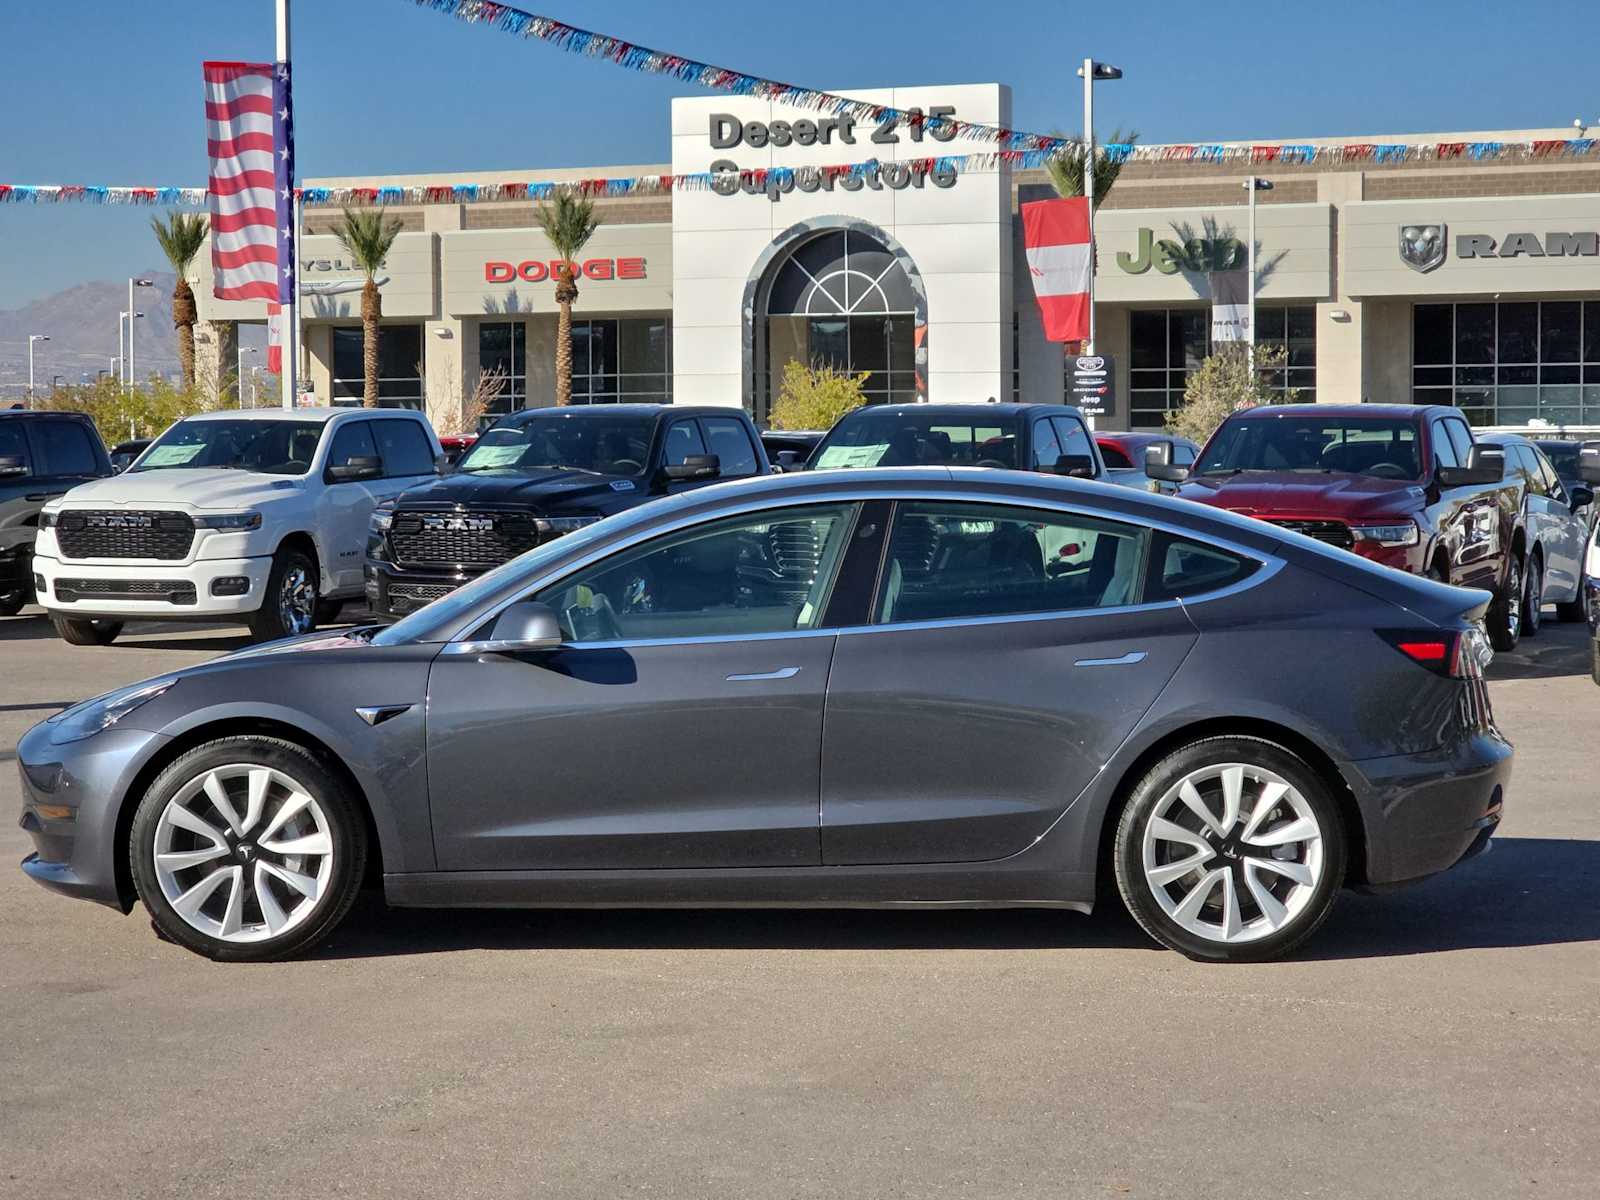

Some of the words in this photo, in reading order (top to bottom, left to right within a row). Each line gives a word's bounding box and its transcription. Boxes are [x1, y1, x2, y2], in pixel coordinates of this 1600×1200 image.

[709, 113, 857, 149] Desert
[871, 106, 958, 144] 215
[709, 159, 958, 202] Superstore
[1456, 232, 1600, 259] RAM
[485, 257, 647, 283] DODGE
[87, 515, 152, 527] RAM
[423, 518, 493, 530] RAM
